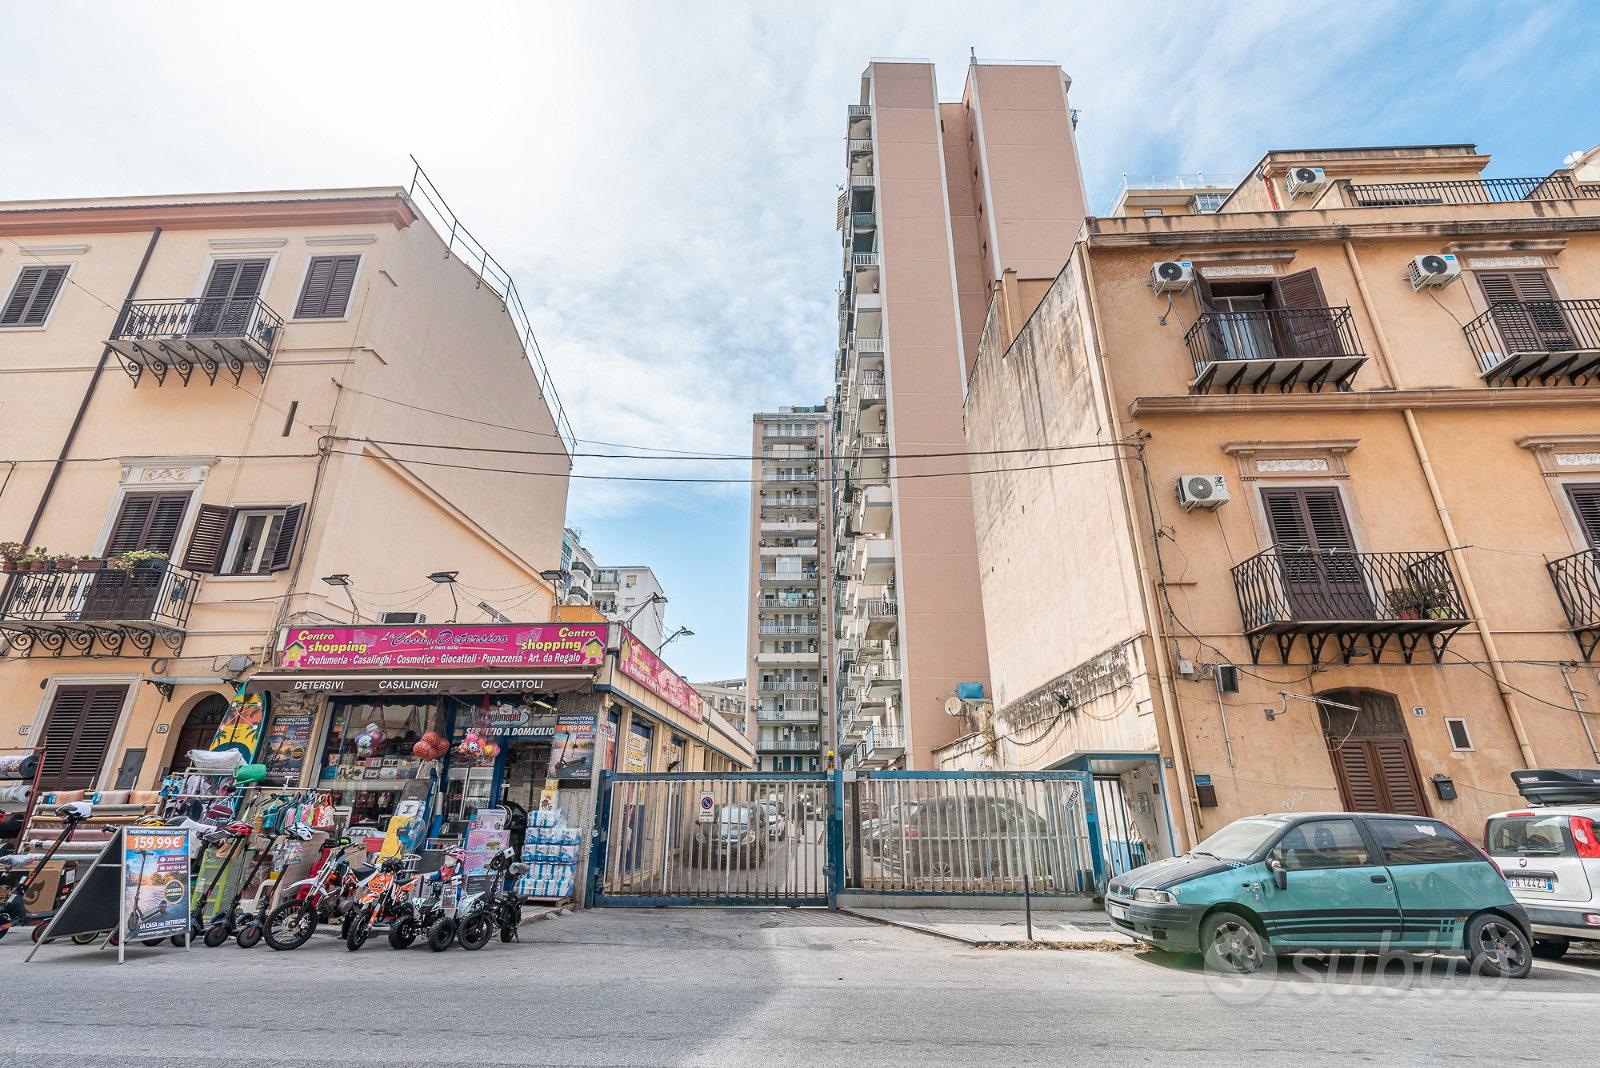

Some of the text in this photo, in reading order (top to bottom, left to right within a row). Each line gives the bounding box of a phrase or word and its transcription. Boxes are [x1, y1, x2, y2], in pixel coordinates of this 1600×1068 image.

[298, 630, 335, 641] Centro
[391, 633, 428, 646] Casa
[439, 629, 508, 644] Detersivo
[558, 627, 597, 638] Centro
[308, 641, 367, 654] shopping
[521, 640, 582, 652] shopping
[307, 652, 581, 666] Profumeria Casalinghi Cosmetica Giocattoli Pupazzeria Art. da Regalo
[294, 680, 544, 690] DETERSIVI CASALINGHI GIOCATTOLI
[503, 728, 510, 736] A
[511, 727, 554, 736] DOMICILIO
[133, 837, 181, 850] 159,99€
